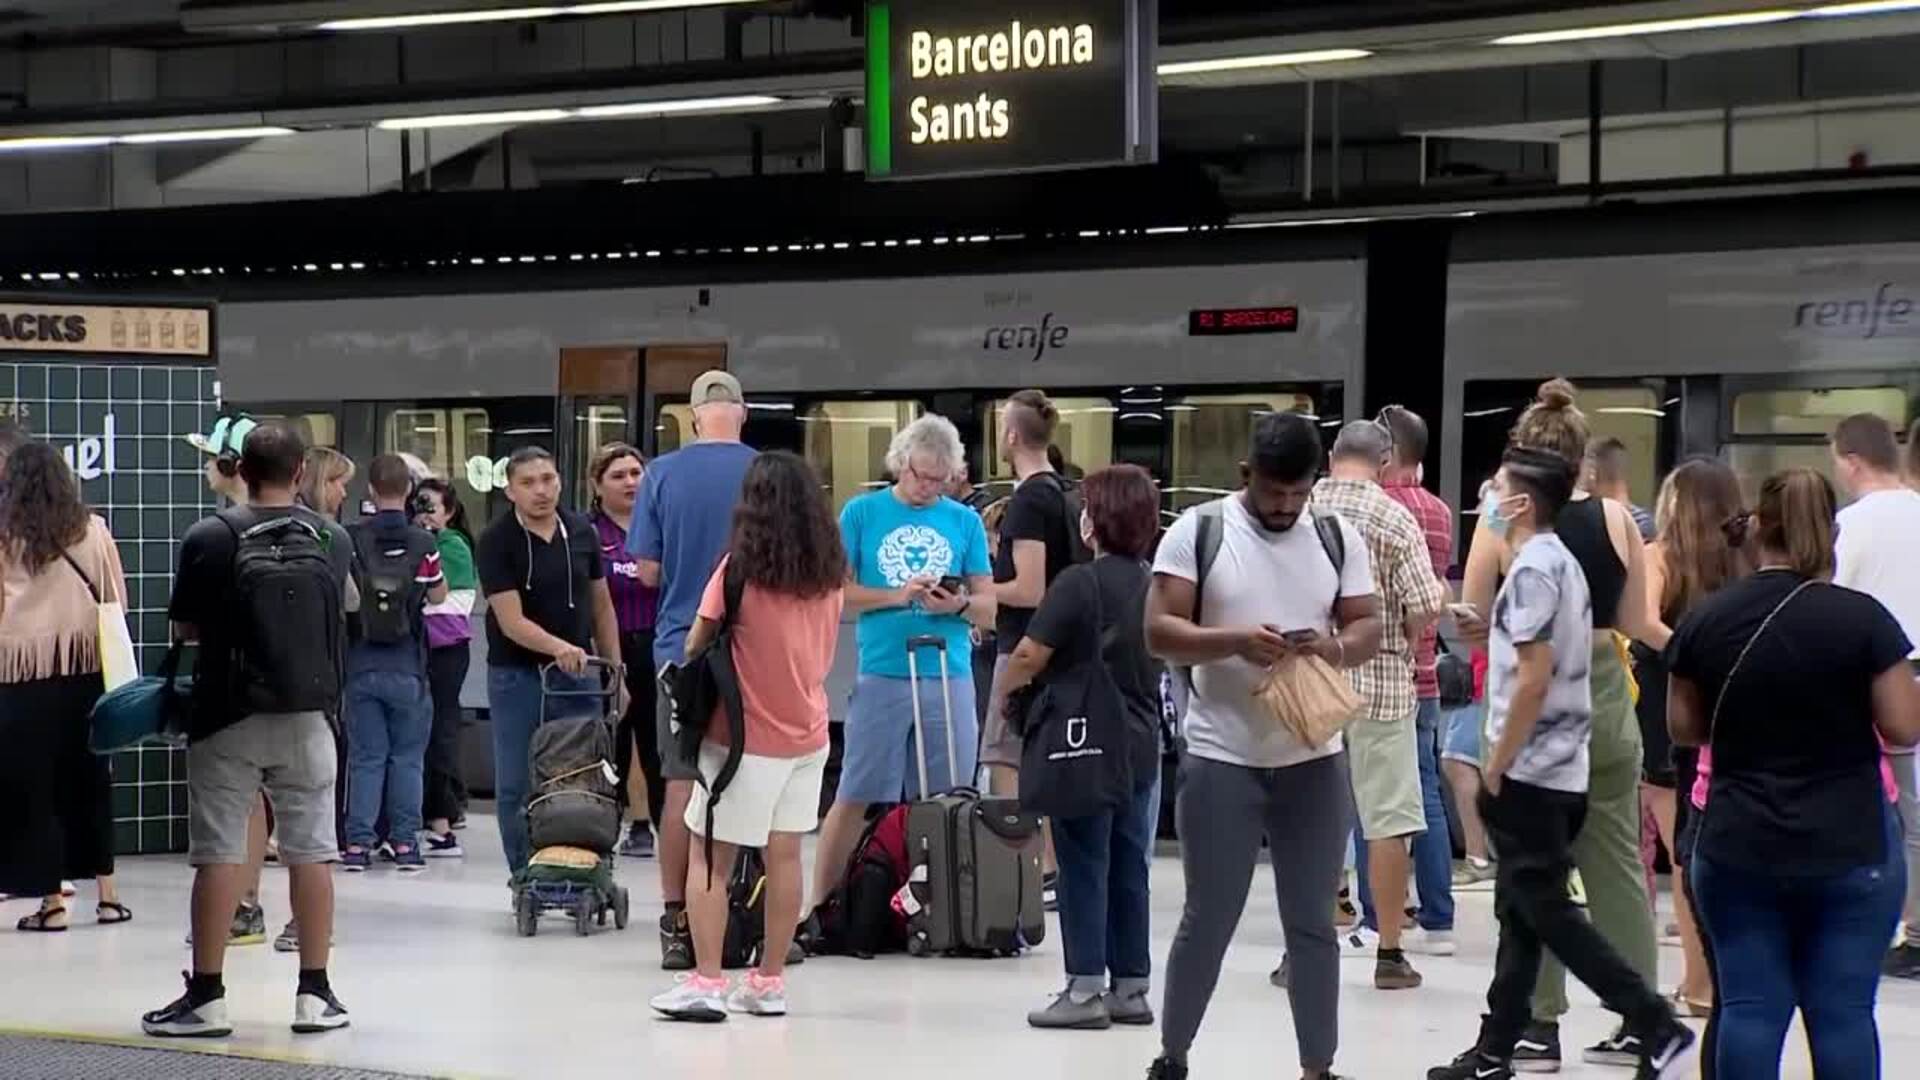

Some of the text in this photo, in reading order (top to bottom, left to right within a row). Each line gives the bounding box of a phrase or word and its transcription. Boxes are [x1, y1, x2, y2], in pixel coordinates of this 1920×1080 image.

[911, 21, 1093, 78] Barcelona
[910, 92, 1009, 144] Sants
[1223, 310, 1294, 327] BARCELONA
[1795, 282, 1912, 339] renfe
[984, 312, 1069, 362] renfe
